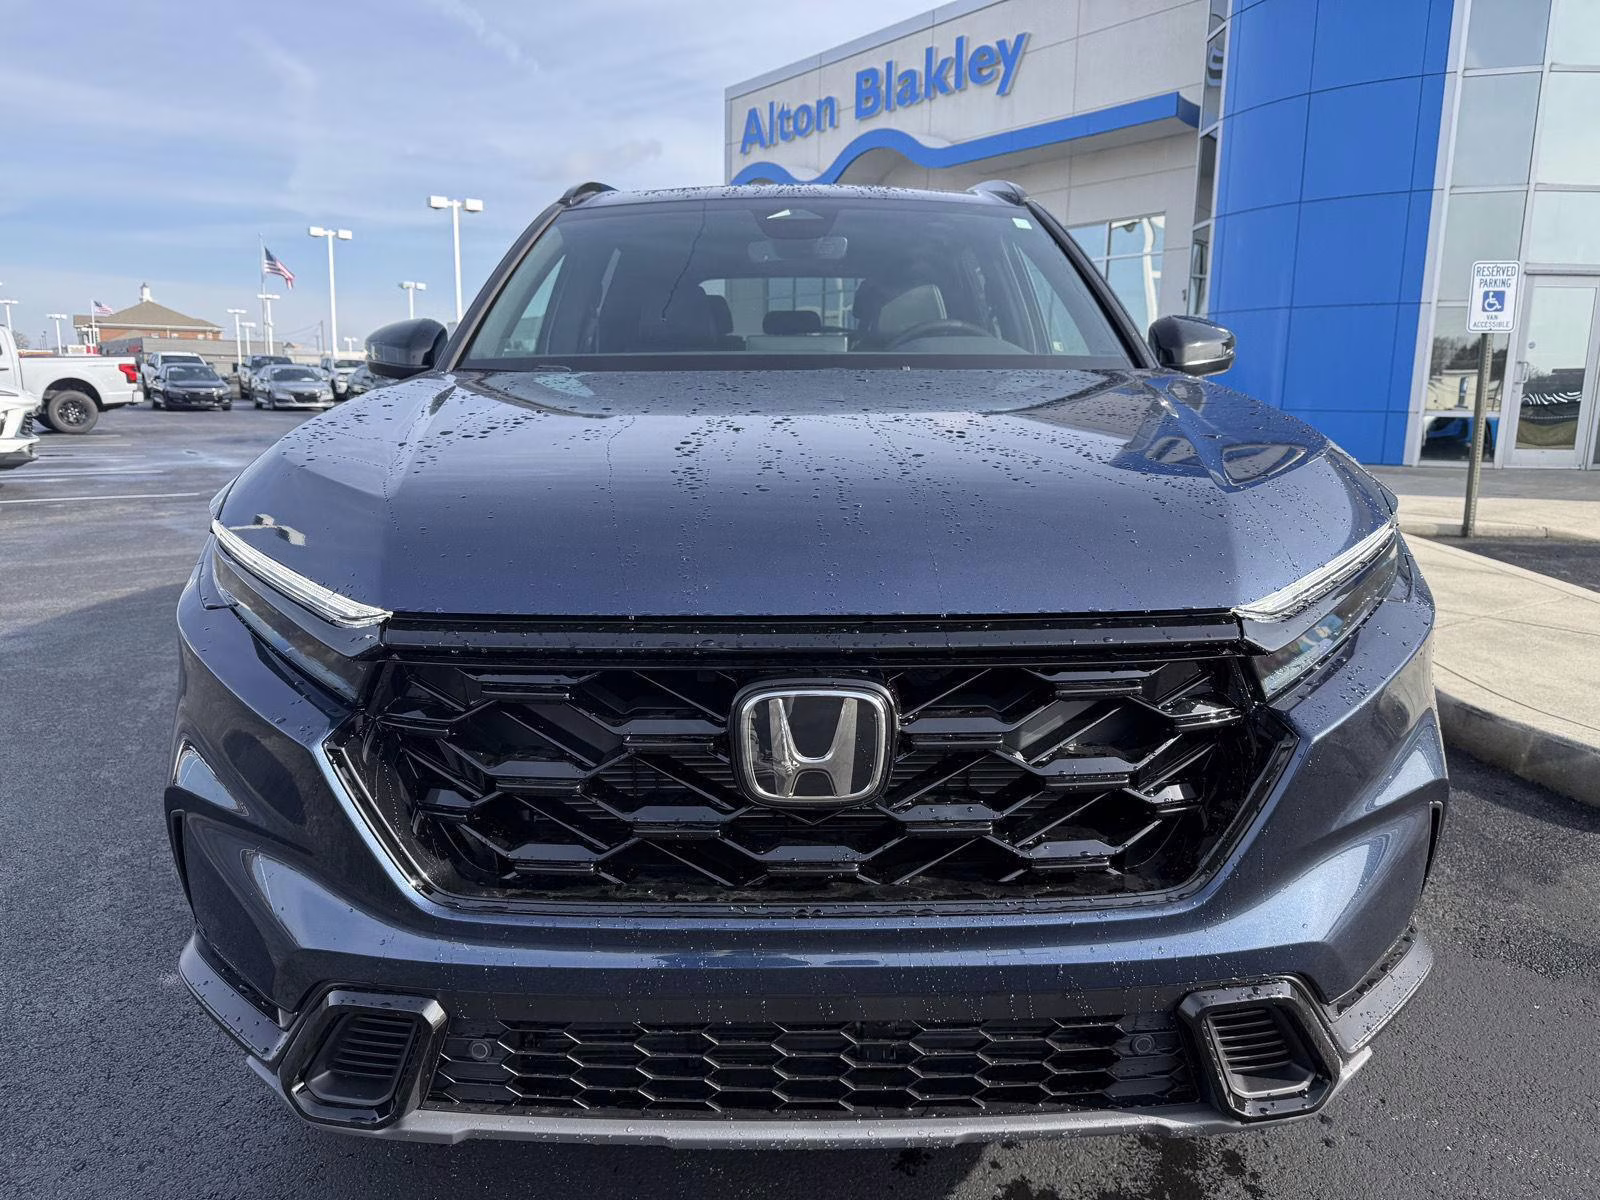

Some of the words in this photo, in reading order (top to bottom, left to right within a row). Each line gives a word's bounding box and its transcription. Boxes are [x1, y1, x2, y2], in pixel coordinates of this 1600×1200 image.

[740, 95, 839, 154] Alton
[854, 32, 1030, 120] Blakley
[1476, 266, 1516, 277] RESERVED
[1479, 278, 1511, 287] PARKING
